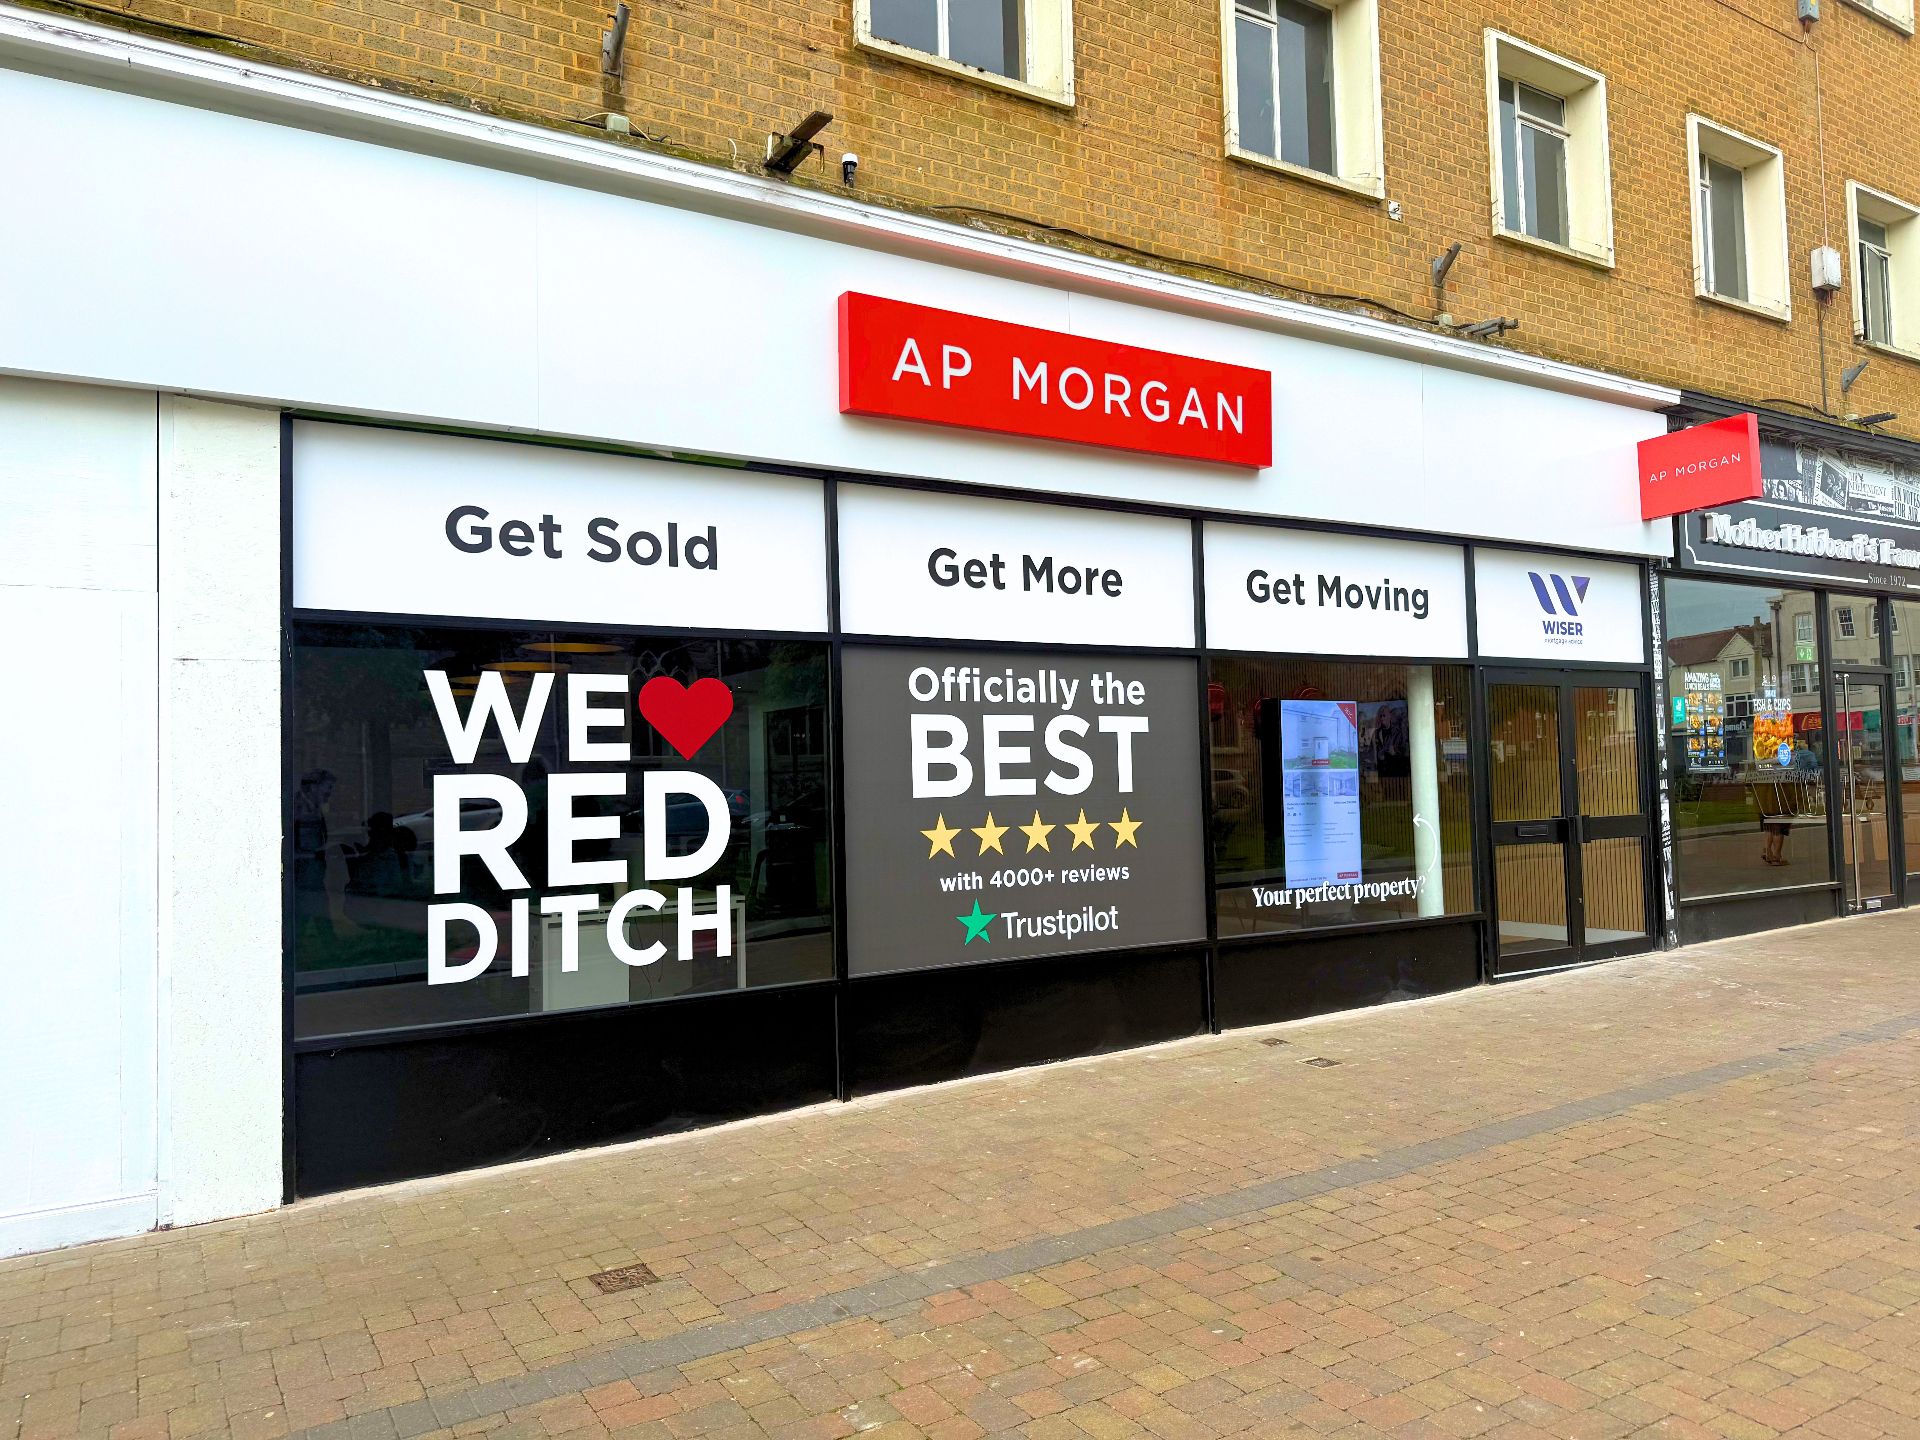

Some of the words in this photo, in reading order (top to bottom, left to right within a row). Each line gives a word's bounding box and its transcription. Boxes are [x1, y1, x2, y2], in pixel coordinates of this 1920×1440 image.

[892, 337, 973, 390] AP
[1012, 356, 1244, 434] MORGAN
[1649, 471, 1667, 484] AP
[1675, 452, 1741, 477] MORGAN
[445, 505, 562, 559] Get
[587, 517, 718, 570] Sold
[1705, 512, 1783, 550] Mother
[1779, 523, 1879, 562] Hubbard's
[928, 547, 1006, 591] Get
[1022, 554, 1123, 597] More
[1246, 569, 1306, 606] Get
[1317, 574, 1429, 620] Moving
[1868, 572, 1887, 584] Since
[1889, 575, 1906, 587] 1972
[1542, 620, 1583, 636] WISER
[908, 666, 1080, 711] Officially
[1091, 671, 1146, 705] the
[1684, 672, 1710, 684] AMAZING
[423, 669, 632, 764] WE
[1753, 698, 1767, 711] FISH
[1767, 699, 1773, 711] &
[1773, 698, 1792, 711] CHIPS
[910, 713, 1150, 799] BEST
[433, 770, 732, 894] RED
[940, 872, 983, 892] with
[989, 867, 1055, 888] 4000+
[1061, 864, 1130, 883] reviews
[1251, 887, 1292, 908] Your
[1295, 881, 1352, 910] perfect
[1352, 875, 1426, 904] property?
[427, 884, 733, 986] DITCH
[1000, 905, 1119, 940] Trustpilot
